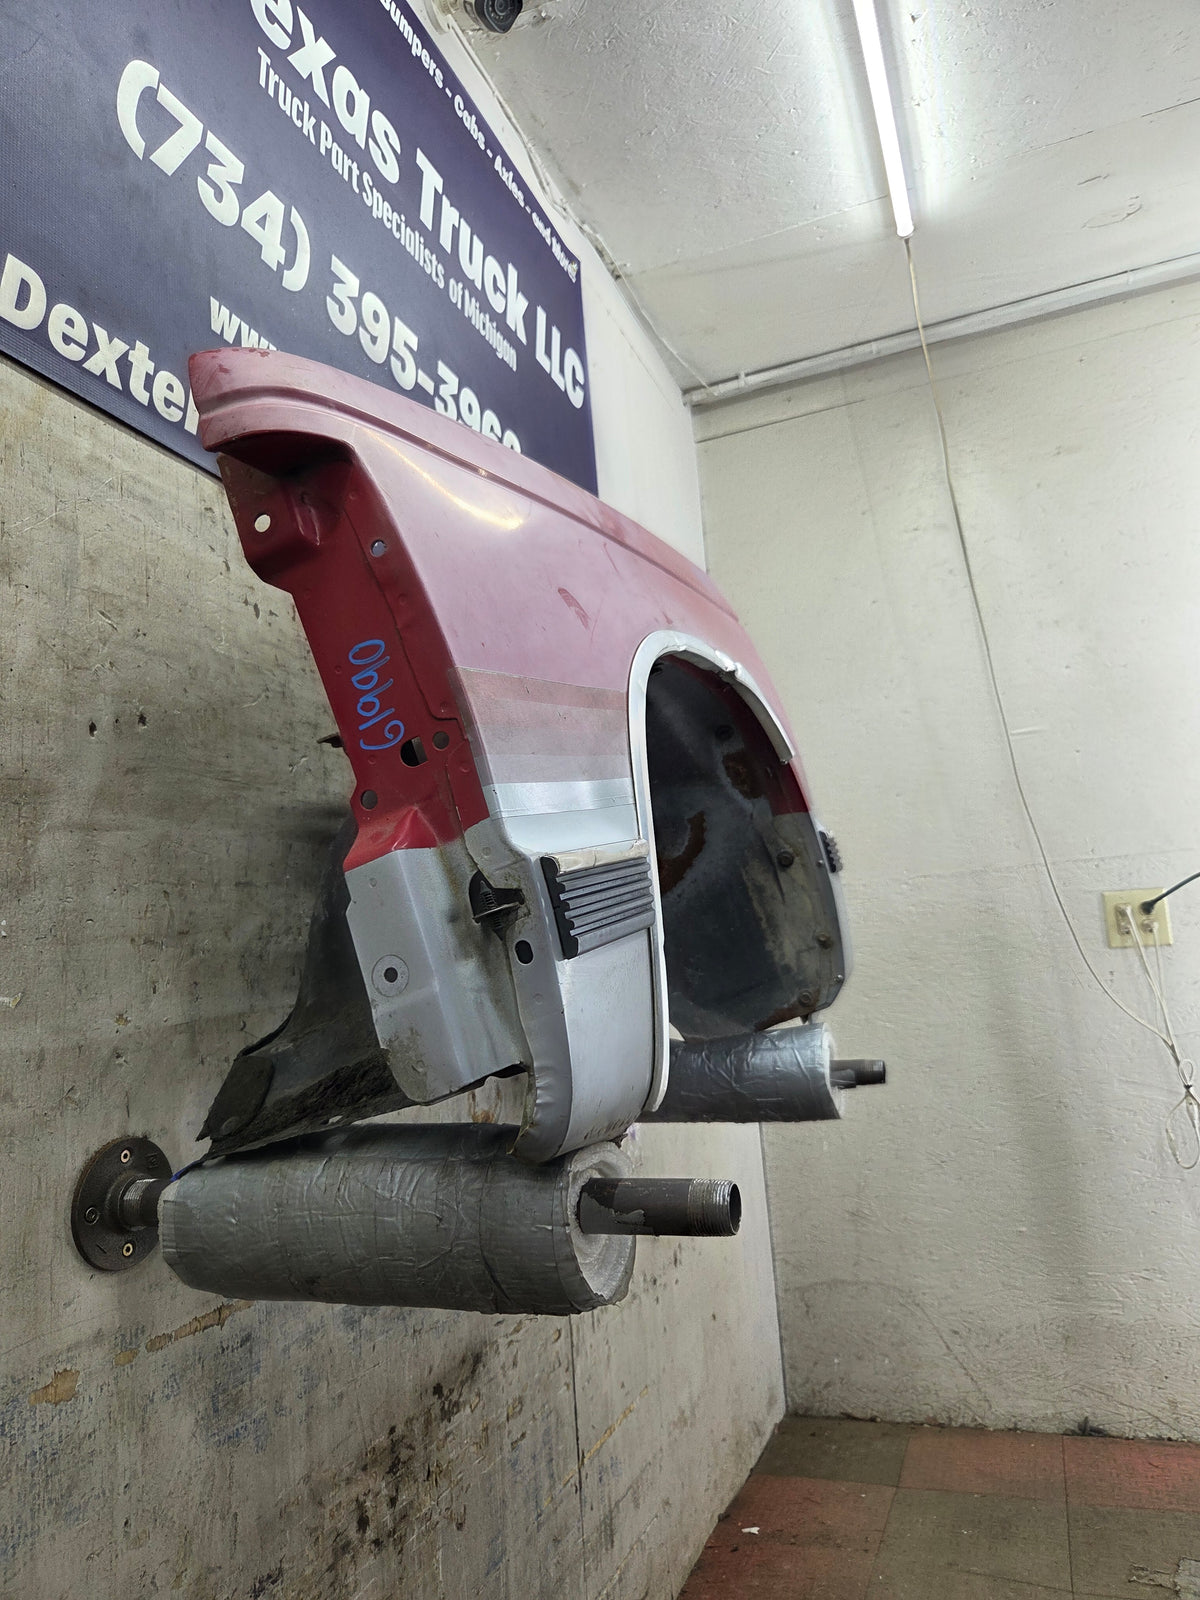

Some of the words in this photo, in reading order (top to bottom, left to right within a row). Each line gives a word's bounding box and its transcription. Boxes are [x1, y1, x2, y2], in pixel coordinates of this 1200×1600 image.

[116, 59, 311, 292] (734)
[257, 46, 317, 145] Truck
[319, 120, 359, 194] Part
[362, 171, 445, 289] Specialists
[449, 277, 463, 310] of
[464, 288, 517, 373] Michigan
[454, 94, 485, 150] Cabs
[494, 155, 525, 207] Axles
[416, 148, 529, 345] Truck
[535, 305, 585, 409] LLC
[348, 639, 405, 750] 61990
